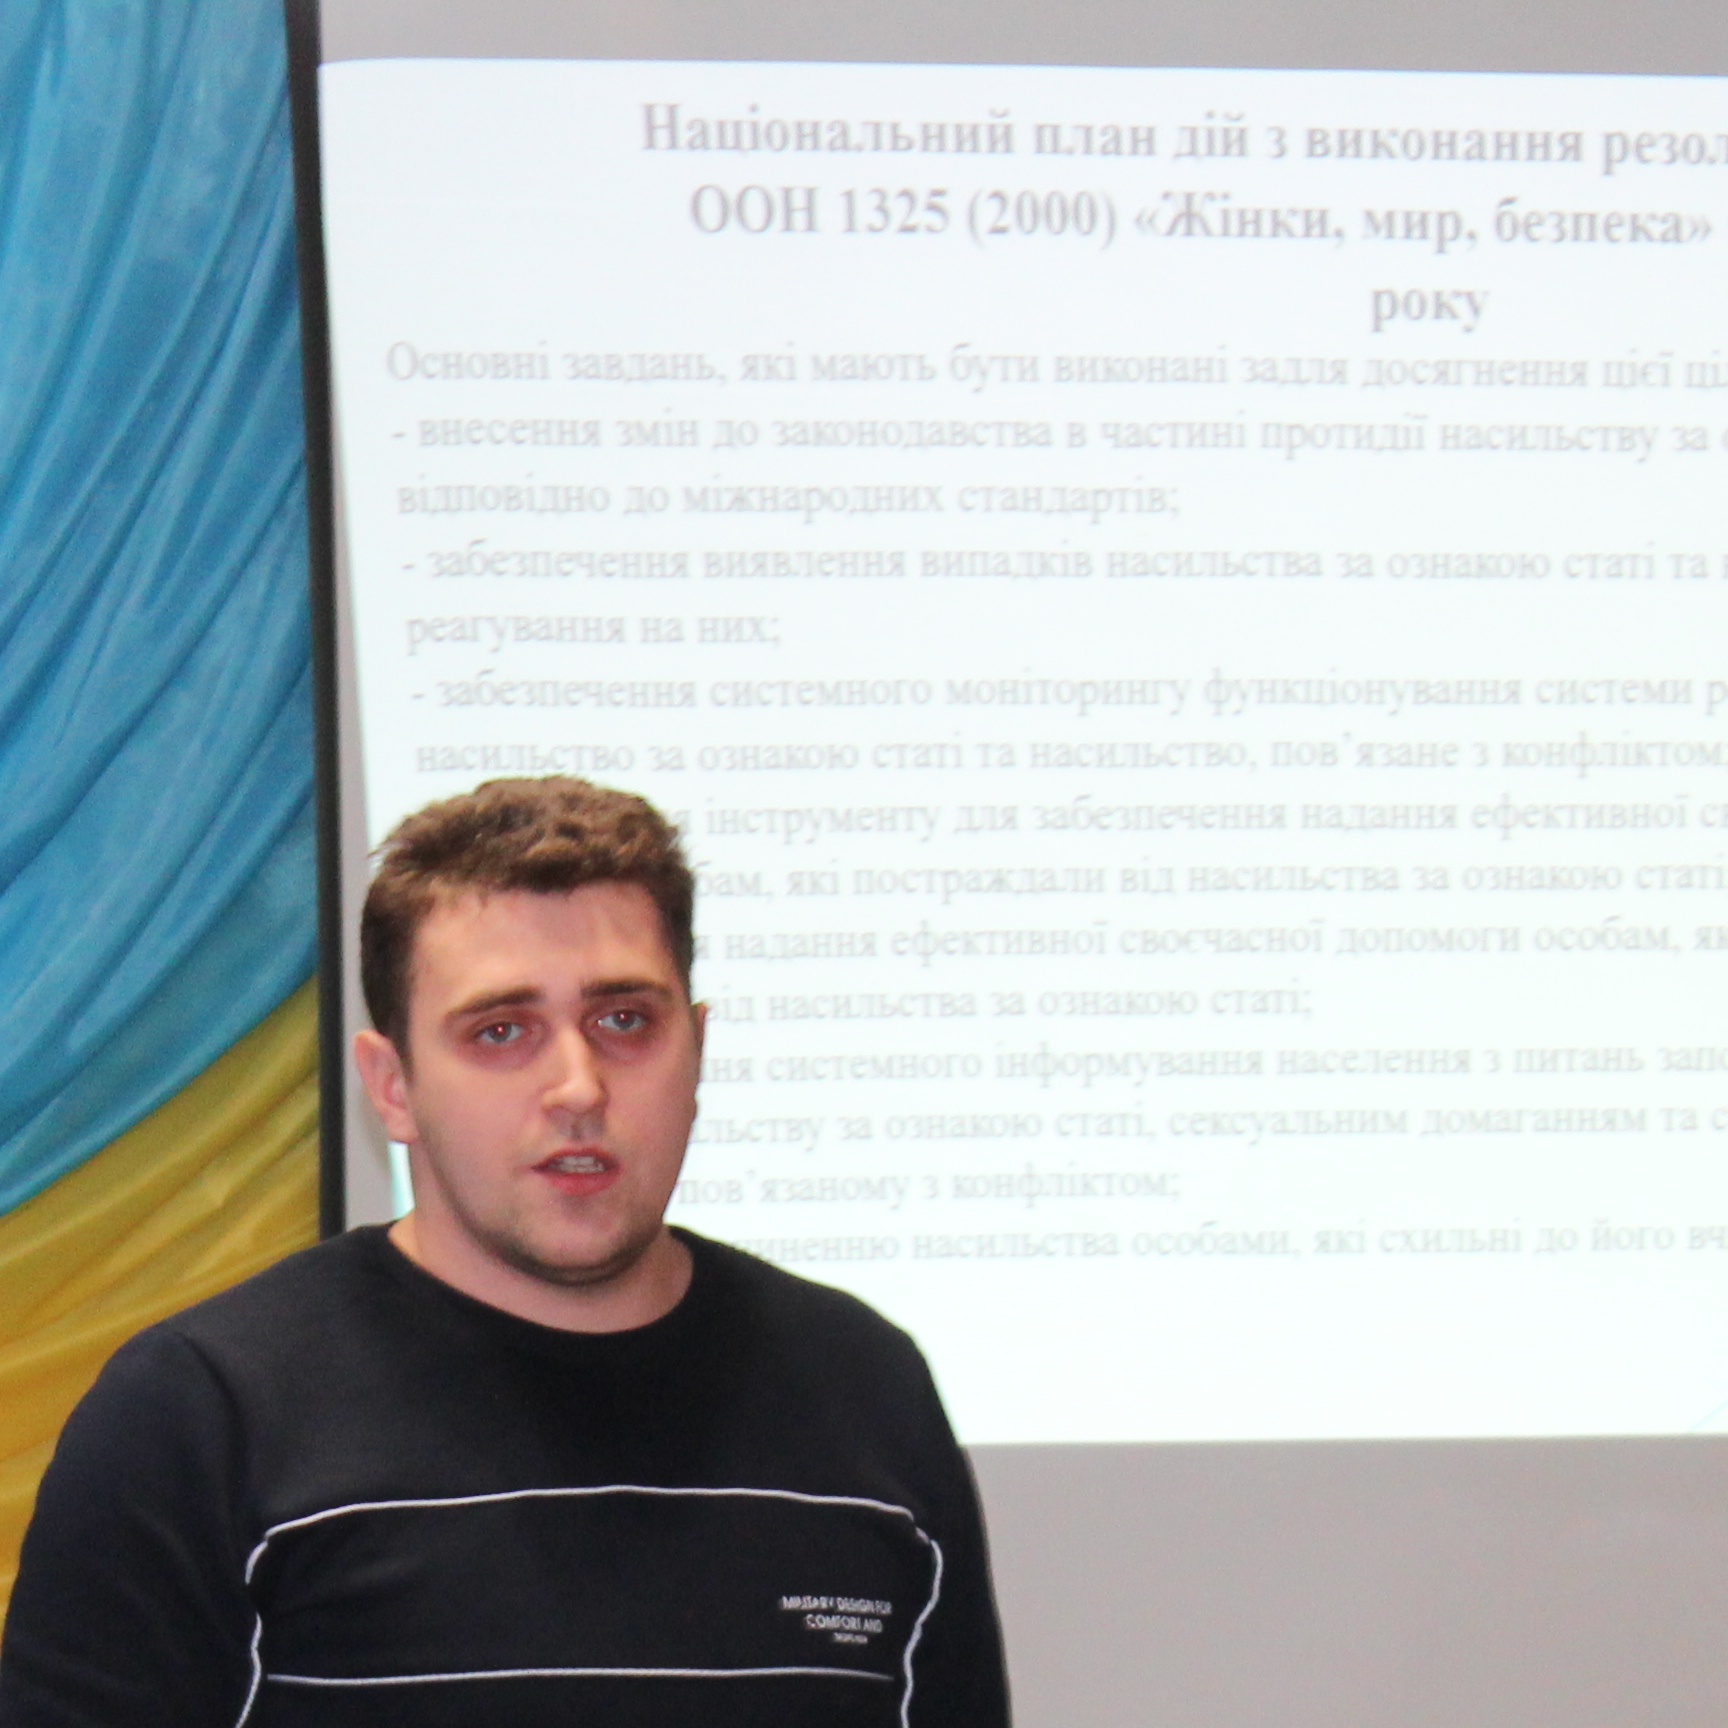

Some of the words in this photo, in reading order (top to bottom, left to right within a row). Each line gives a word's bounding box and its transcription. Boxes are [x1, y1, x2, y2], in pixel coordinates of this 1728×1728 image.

[641, 103, 1015, 155] Національний
[1033, 123, 1157, 157] план
[1173, 110, 1249, 160] дій
[1266, 125, 1289, 160] з
[1305, 127, 1584, 163] виконання
[689, 184, 819, 235] ООН
[841, 187, 951, 235] 1325
[966, 189, 1118, 249] (2000)
[1133, 190, 1346, 247] «Жінки,
[1363, 209, 1478, 256] мир,
[1493, 196, 1713, 245] безпека»
[1371, 288, 1489, 334] року
[386, 340, 549, 381] Основні
[564, 354, 726, 383] завдань,
[740, 341, 797, 382] які
[811, 354, 937, 381] мають
[949, 342, 1039, 394] бути
[1054, 345, 1227, 383] виконані
[1243, 357, 1348, 386] задля
[1362, 359, 1588, 388] досягнення
[1603, 348, 1674, 389] цієї
[419, 419, 601, 447] внесення
[617, 407, 698, 447] змін
[712, 420, 760, 450] до
[773, 421, 1053, 449] законодавства
[1067, 421, 1087, 449] в
[1101, 410, 1246, 449] частині
[1261, 414, 1427, 461] протидії
[1440, 425, 1658, 464] насильству
[1672, 426, 1710, 453] за
[398, 473, 610, 515] відповідно
[623, 486, 670, 516] до
[684, 474, 943, 525] міжнародних
[959, 475, 1178, 525] стандартів;
[428, 538, 689, 579] забезпечення
[704, 551, 906, 578] виявлення
[921, 539, 1093, 579] випадків
[1107, 551, 1323, 578] насильства
[1336, 552, 1375, 579] за
[1387, 554, 1551, 579] ознакою
[1564, 542, 1654, 579] статі
[1668, 553, 1710, 580] та
[406, 616, 625, 656] реагування
[640, 617, 685, 644] на
[698, 615, 782, 650] них;
[438, 668, 696, 708] забезпечення
[710, 680, 932, 707] системного
[947, 680, 1188, 717] моніторингу
[1204, 668, 1521, 716] функціонування
[1536, 679, 1692, 705] системи
[416, 741, 636, 773] насильство
[648, 744, 686, 772] за
[699, 745, 859, 771] ознакою
[873, 732, 962, 769] статі
[976, 743, 1016, 769] та
[1031, 743, 1257, 770] насильство,
[1473, 743, 1489, 768] з
[706, 798, 937, 846] інструменту
[953, 805, 1018, 834] для
[1036, 794, 1286, 831] забезпечення
[1302, 805, 1456, 832] надання
[1472, 794, 1686, 840] ефективної
[693, 858, 773, 903] бам,
[787, 858, 840, 897] які
[855, 868, 1105, 905] постраждали
[1120, 857, 1175, 895] від
[1189, 867, 1400, 892] насильства
[1414, 867, 1450, 891] за
[1463, 867, 1622, 890] ознакою
[725, 929, 877, 962] надання
[892, 920, 1104, 967] ефективної
[1121, 919, 1324, 955] своєчасної
[1336, 928, 1520, 954] допомоги
[1534, 915, 1680, 952] особам,
[770, 993, 977, 1020] насильства
[995, 994, 1025, 1016] за
[1039, 992, 1197, 1015] ознакою
[1211, 978, 1310, 1015] статі;
[768, 1055, 983, 1081] системного
[997, 1043, 1262, 1088] інформування
[1278, 1050, 1470, 1074] населення
[1485, 1049, 1501, 1073] з
[1515, 1048, 1644, 1073] питань
[838, 1117, 873, 1141] за
[886, 1115, 1041, 1139] ознакою
[1056, 1103, 1156, 1141] статі,
[1168, 1107, 1407, 1146] сексуальним
[1421, 1109, 1646, 1135] домаганням
[1661, 1108, 1699, 1133] та
[924, 1176, 939, 1199] з
[954, 1164, 1178, 1208] конфліктом;
[914, 1233, 1119, 1259] насильства
[1131, 1220, 1302, 1257] особами,
[1314, 1219, 1365, 1254] які
[1378, 1218, 1523, 1255] схильні
[1535, 1228, 1579, 1254] до
[1591, 1219, 1675, 1251] його
